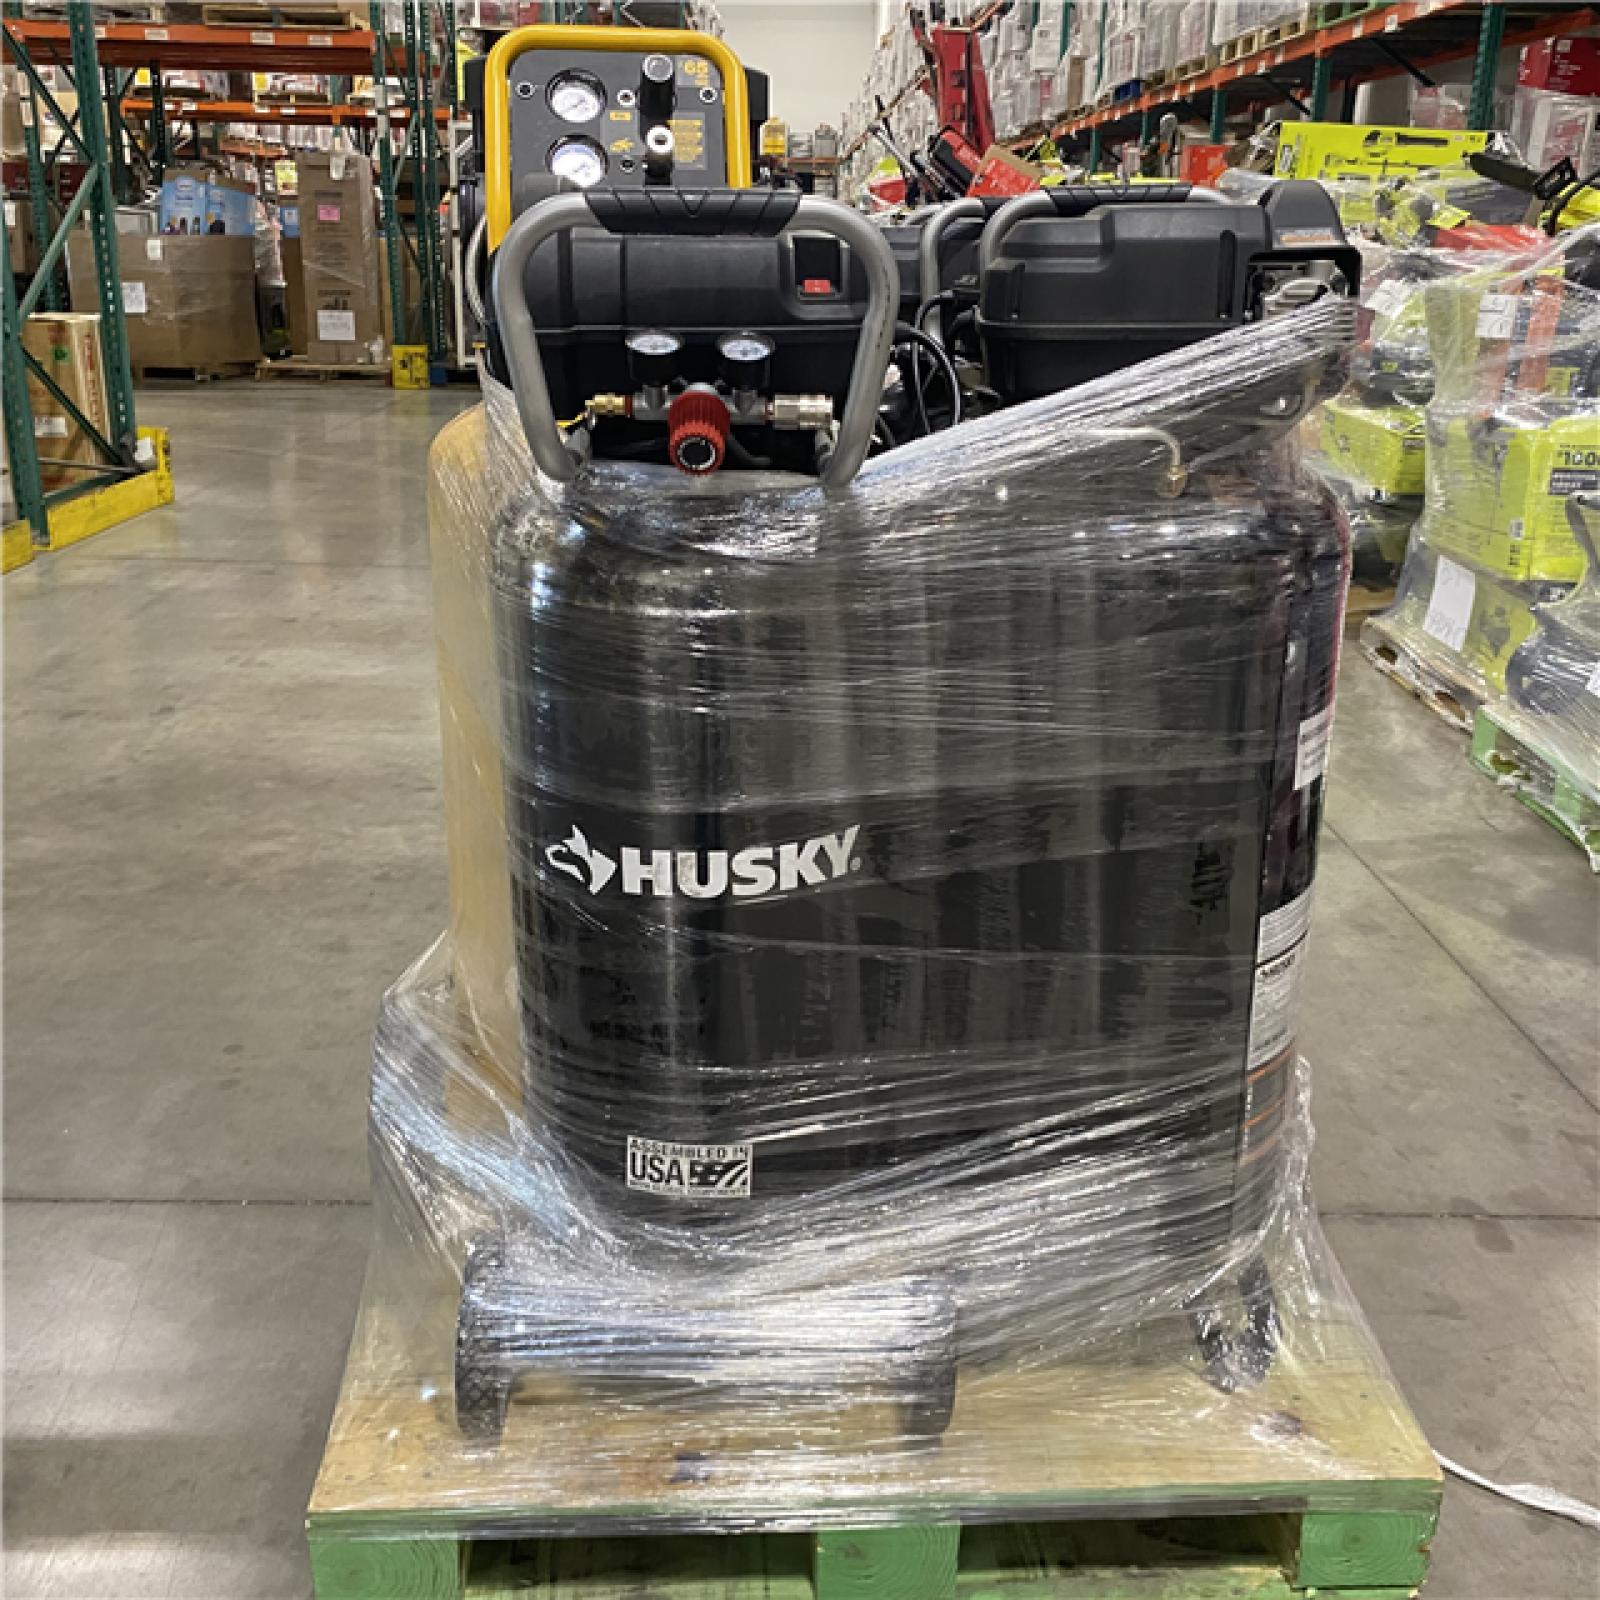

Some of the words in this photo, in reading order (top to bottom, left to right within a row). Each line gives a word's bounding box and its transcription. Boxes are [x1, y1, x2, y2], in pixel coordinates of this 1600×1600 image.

[622, 824, 860, 898] HUSKY
[629, 1137, 725, 1158] ASSEMBLED
[631, 1150, 684, 1186] USA
